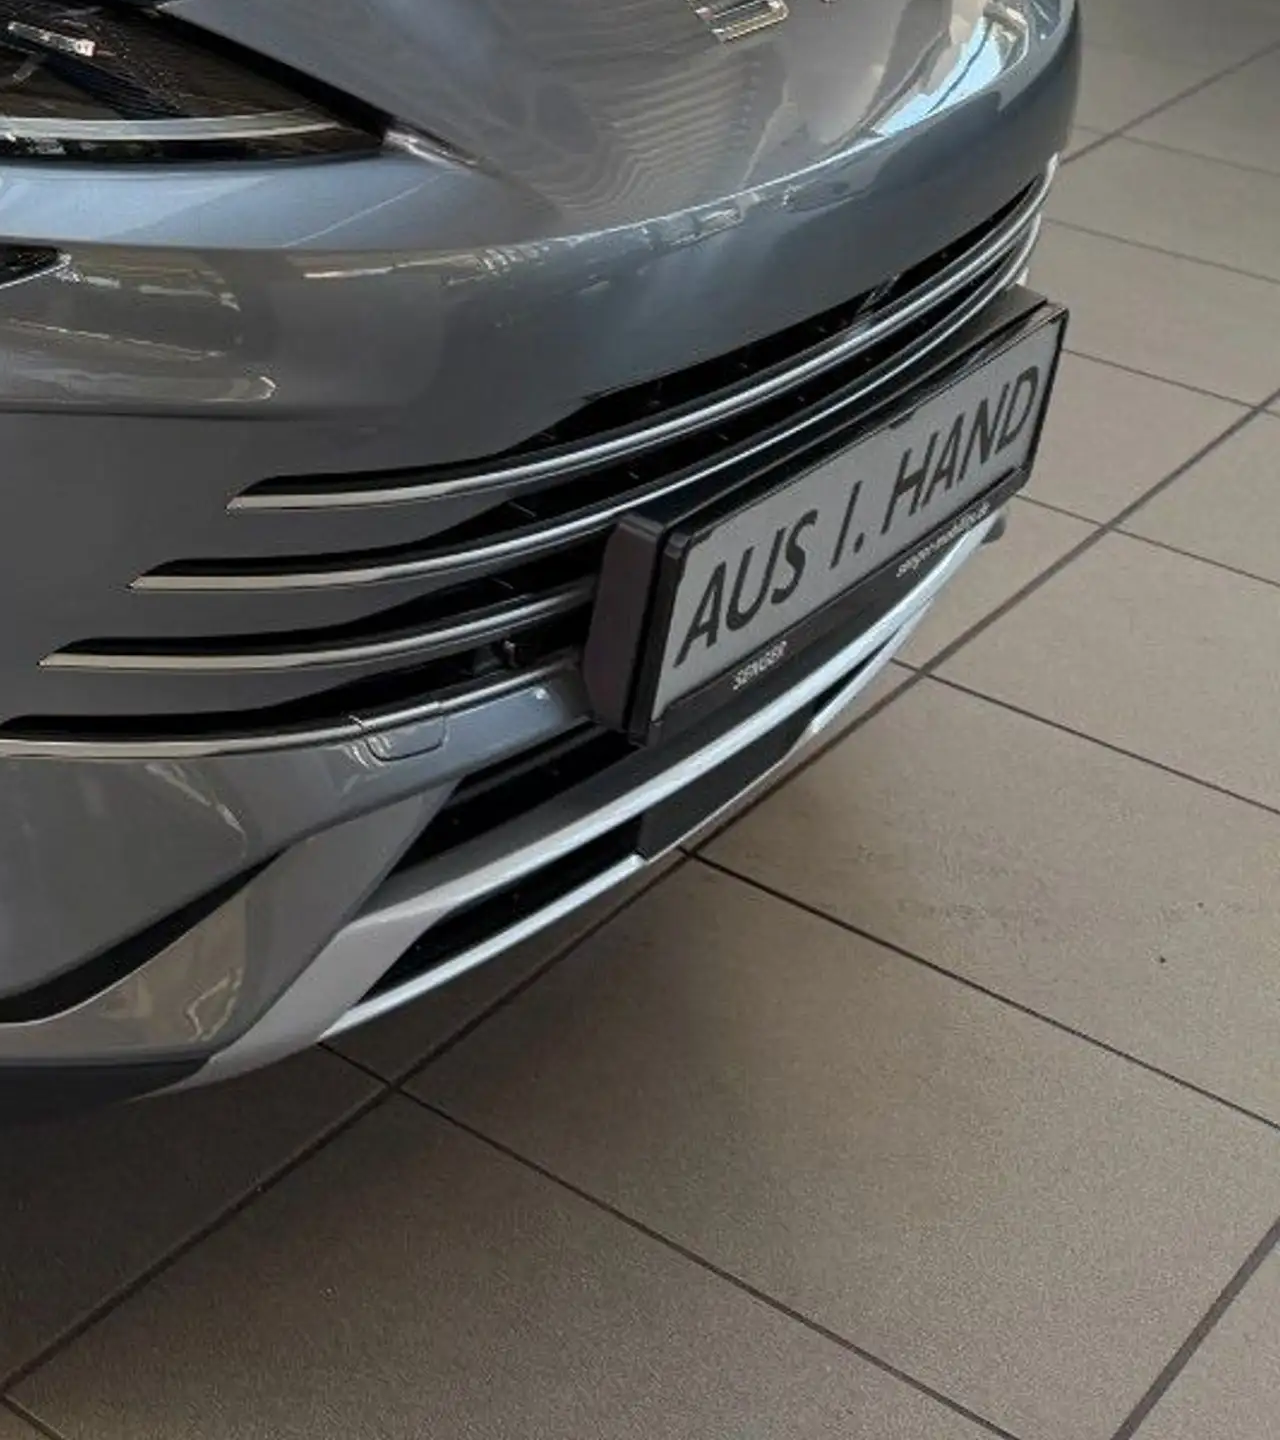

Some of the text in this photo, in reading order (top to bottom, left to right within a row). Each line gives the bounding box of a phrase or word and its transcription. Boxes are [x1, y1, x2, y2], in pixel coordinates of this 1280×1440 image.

[673, 508, 819, 668] AUS
[827, 480, 865, 571] I.
[880, 364, 1040, 536] HAND
